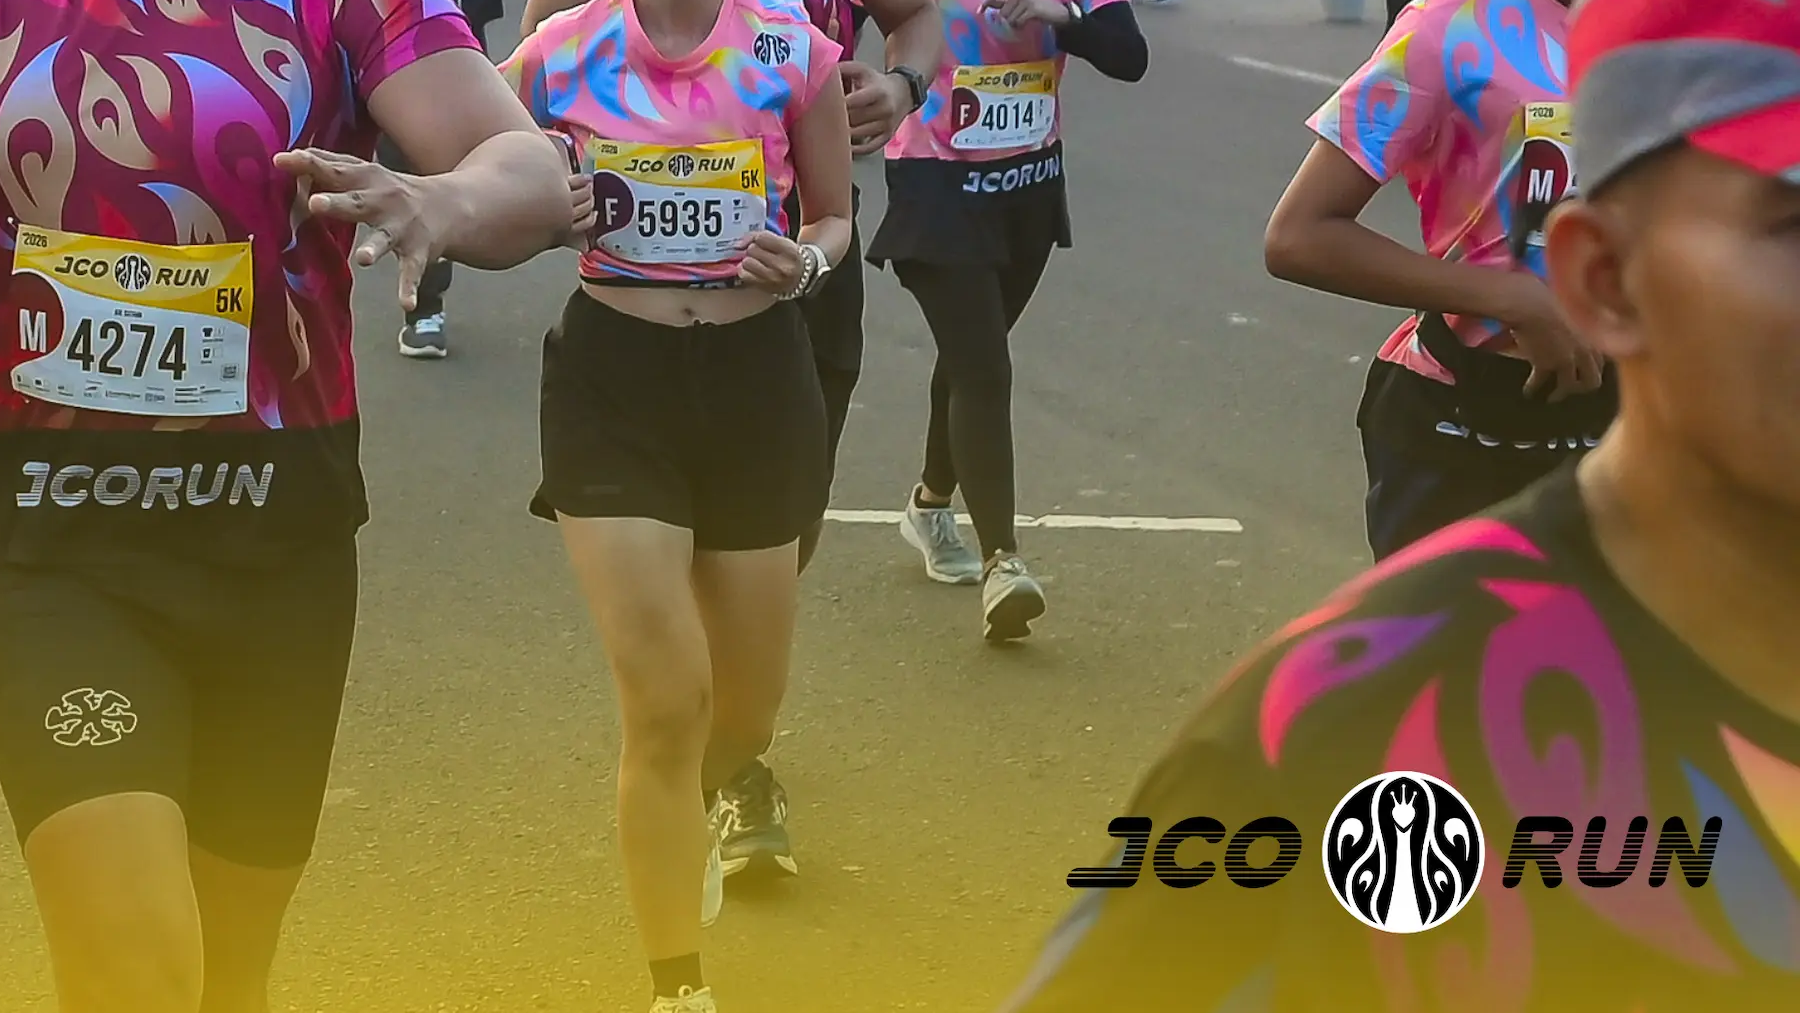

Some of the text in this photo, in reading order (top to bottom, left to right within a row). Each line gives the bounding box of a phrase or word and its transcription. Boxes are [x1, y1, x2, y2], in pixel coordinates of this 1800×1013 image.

[974, 76, 1001, 86] JCO
[960, 100, 1034, 131] F 4014
[624, 157, 736, 173] JCO RUN
[741, 169, 761, 189] 5K
[962, 154, 1061, 193] JCORUN
[1527, 168, 1555, 205] M
[604, 198, 723, 238] F 5935
[54, 256, 210, 287] JCO RUN
[216, 287, 243, 313] 5K
[19, 309, 187, 381] M 4274
[16, 462, 274, 510] JCORUN
